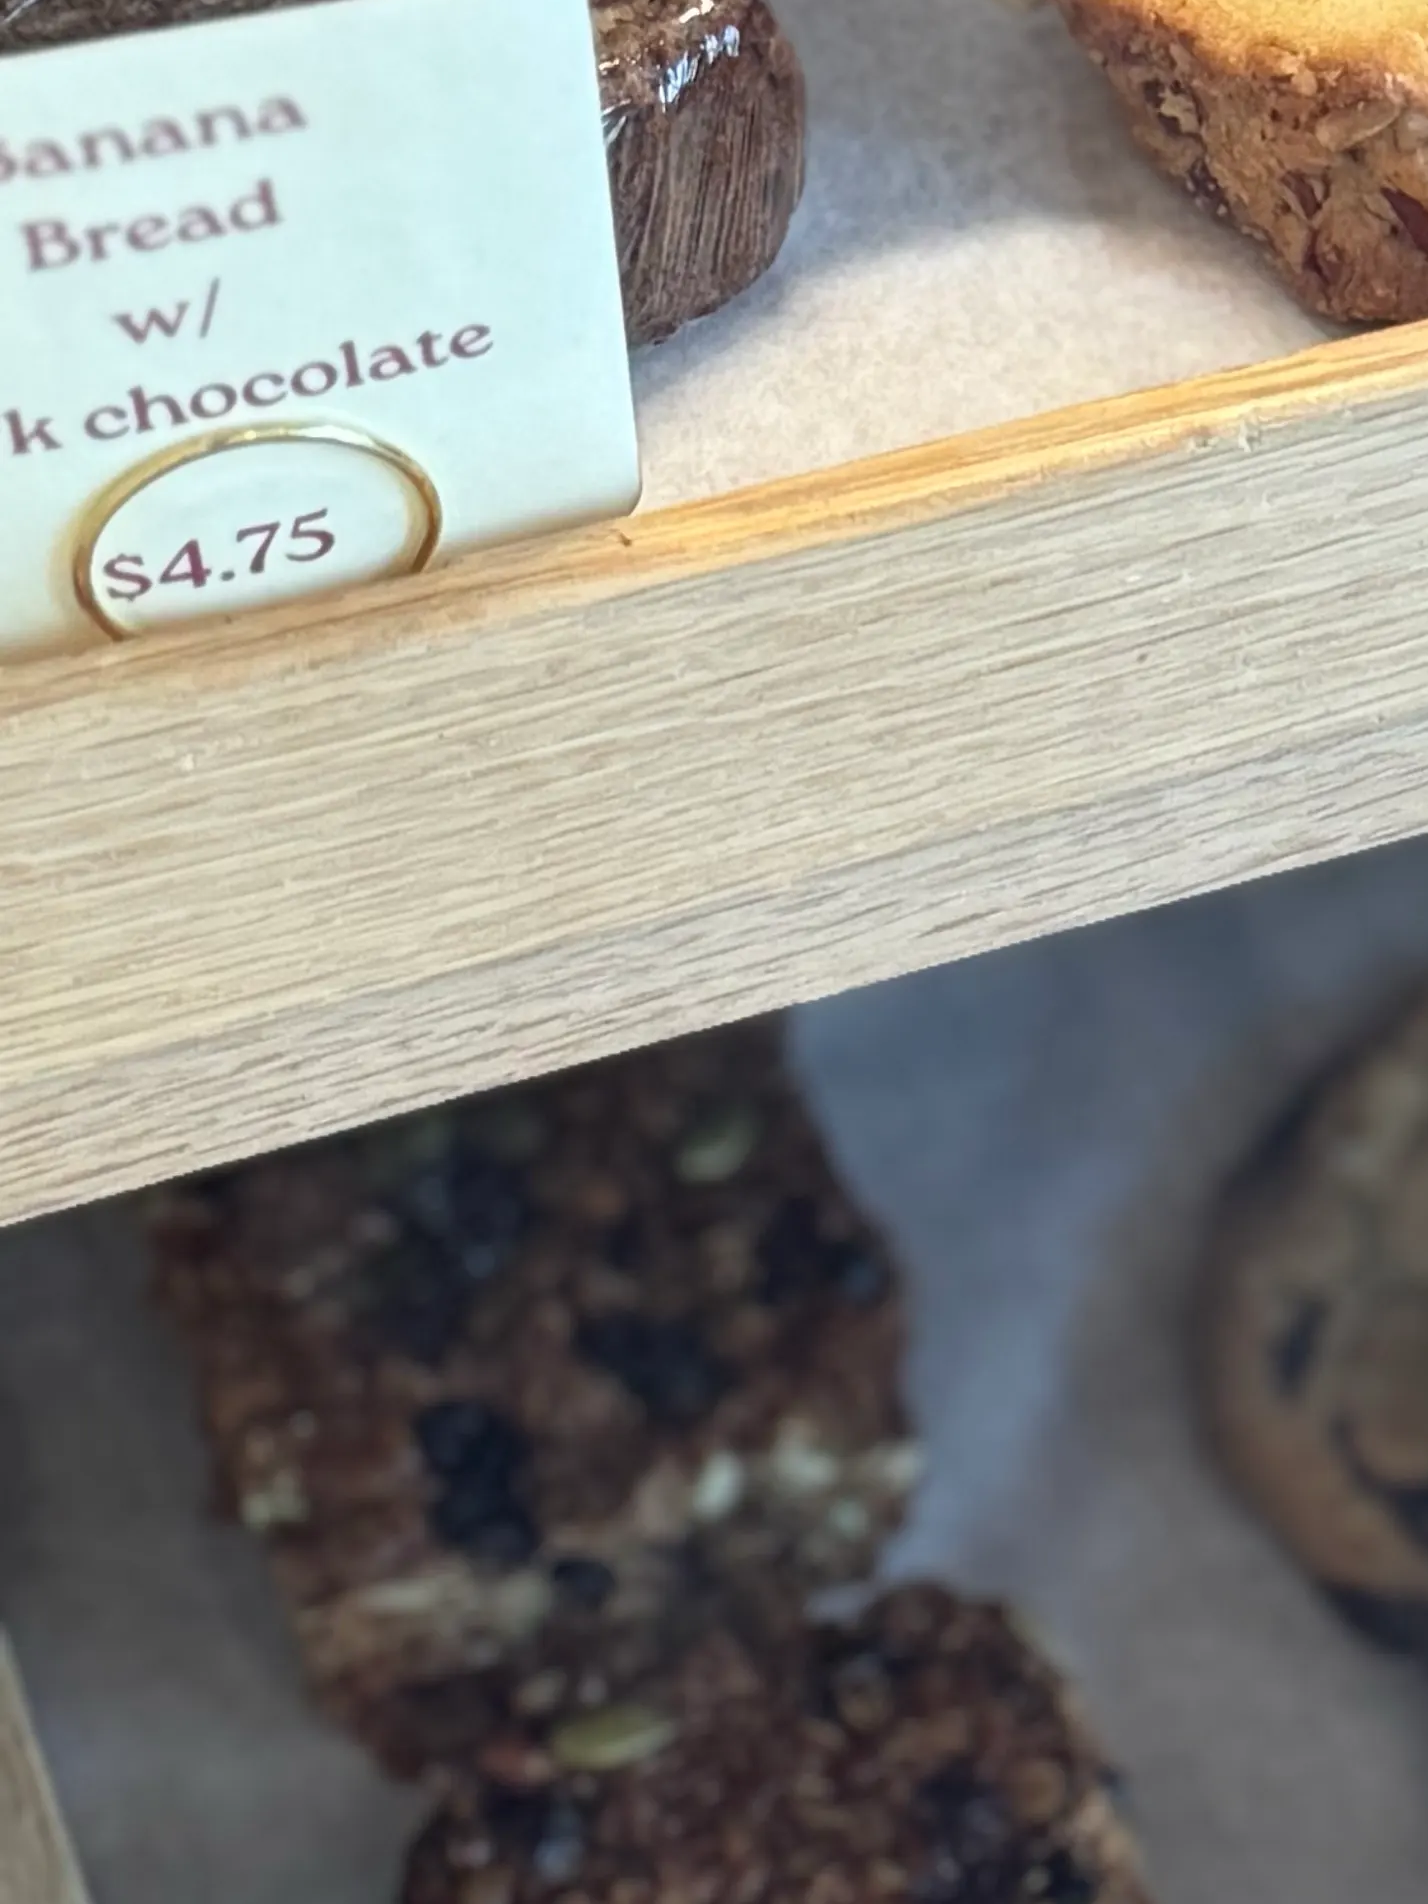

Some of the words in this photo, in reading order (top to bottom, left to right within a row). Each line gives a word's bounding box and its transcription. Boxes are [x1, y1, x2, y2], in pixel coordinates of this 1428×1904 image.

[19, 178, 283, 272] Bread
[111, 276, 221, 346] w/
[82, 322, 494, 441] chocolate
[102, 508, 337, 601] $4.75
